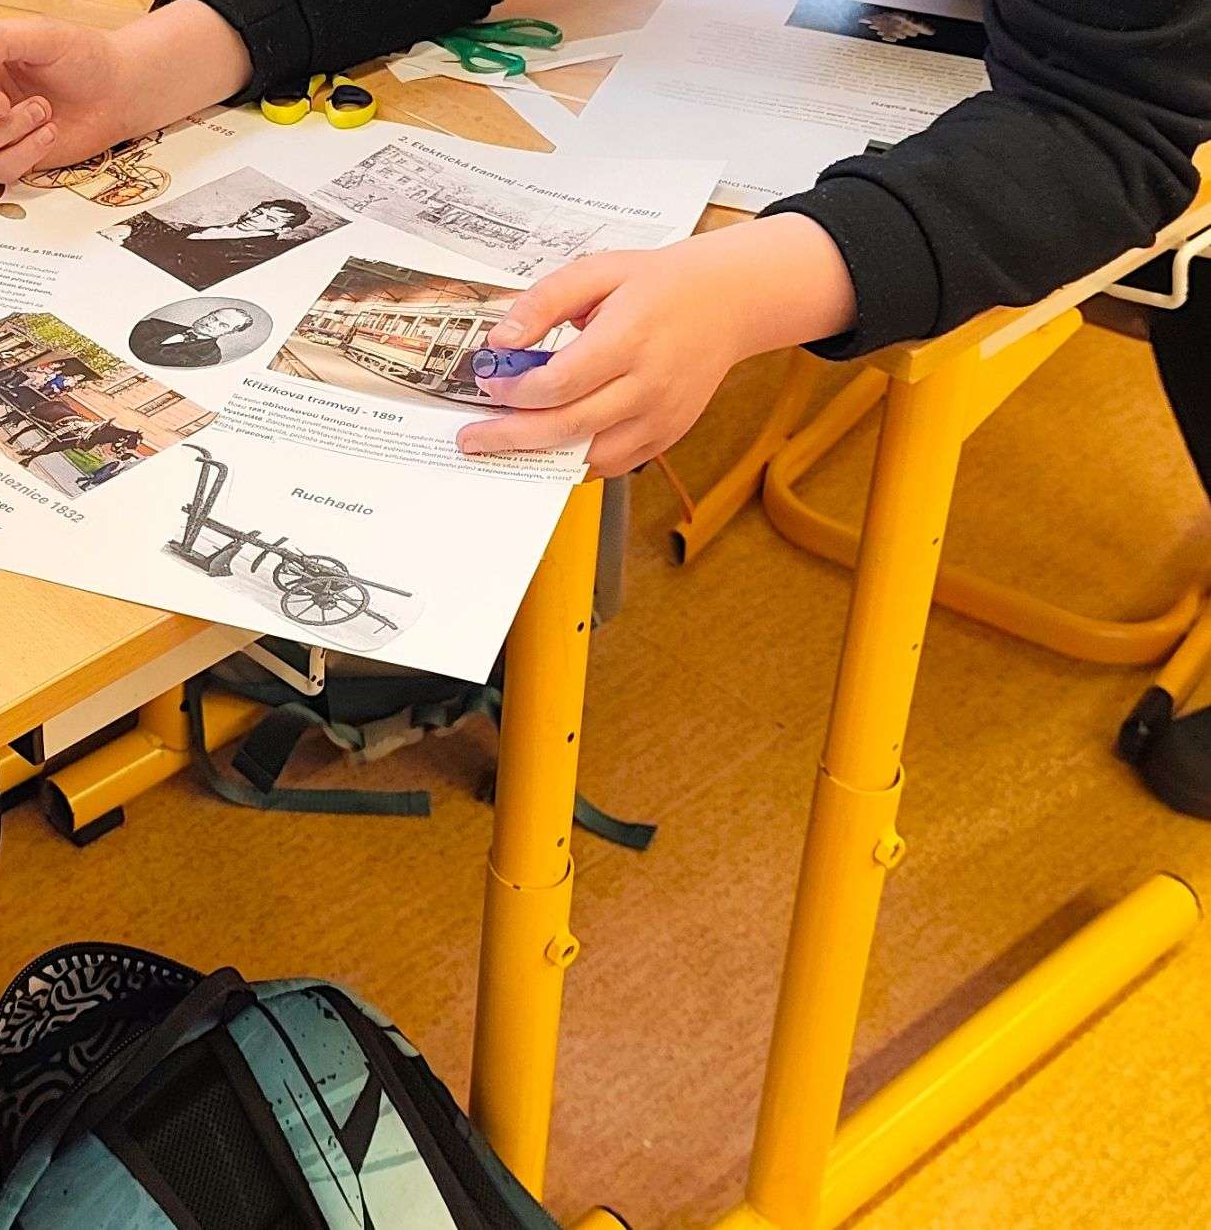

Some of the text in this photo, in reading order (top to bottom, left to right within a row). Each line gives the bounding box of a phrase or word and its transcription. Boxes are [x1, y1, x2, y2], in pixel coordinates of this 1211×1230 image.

[411, 140, 470, 169] Elektrická
[469, 164, 517, 187] tramvaj
[525, 183, 583, 206] František
[243, 377, 305, 401] Křižíkova
[307, 396, 362, 415] tramvaj
[372, 410, 404, 423] 1891
[49, 500, 85, 523] 1832
[291, 488, 375, 516] Ruchadlo
